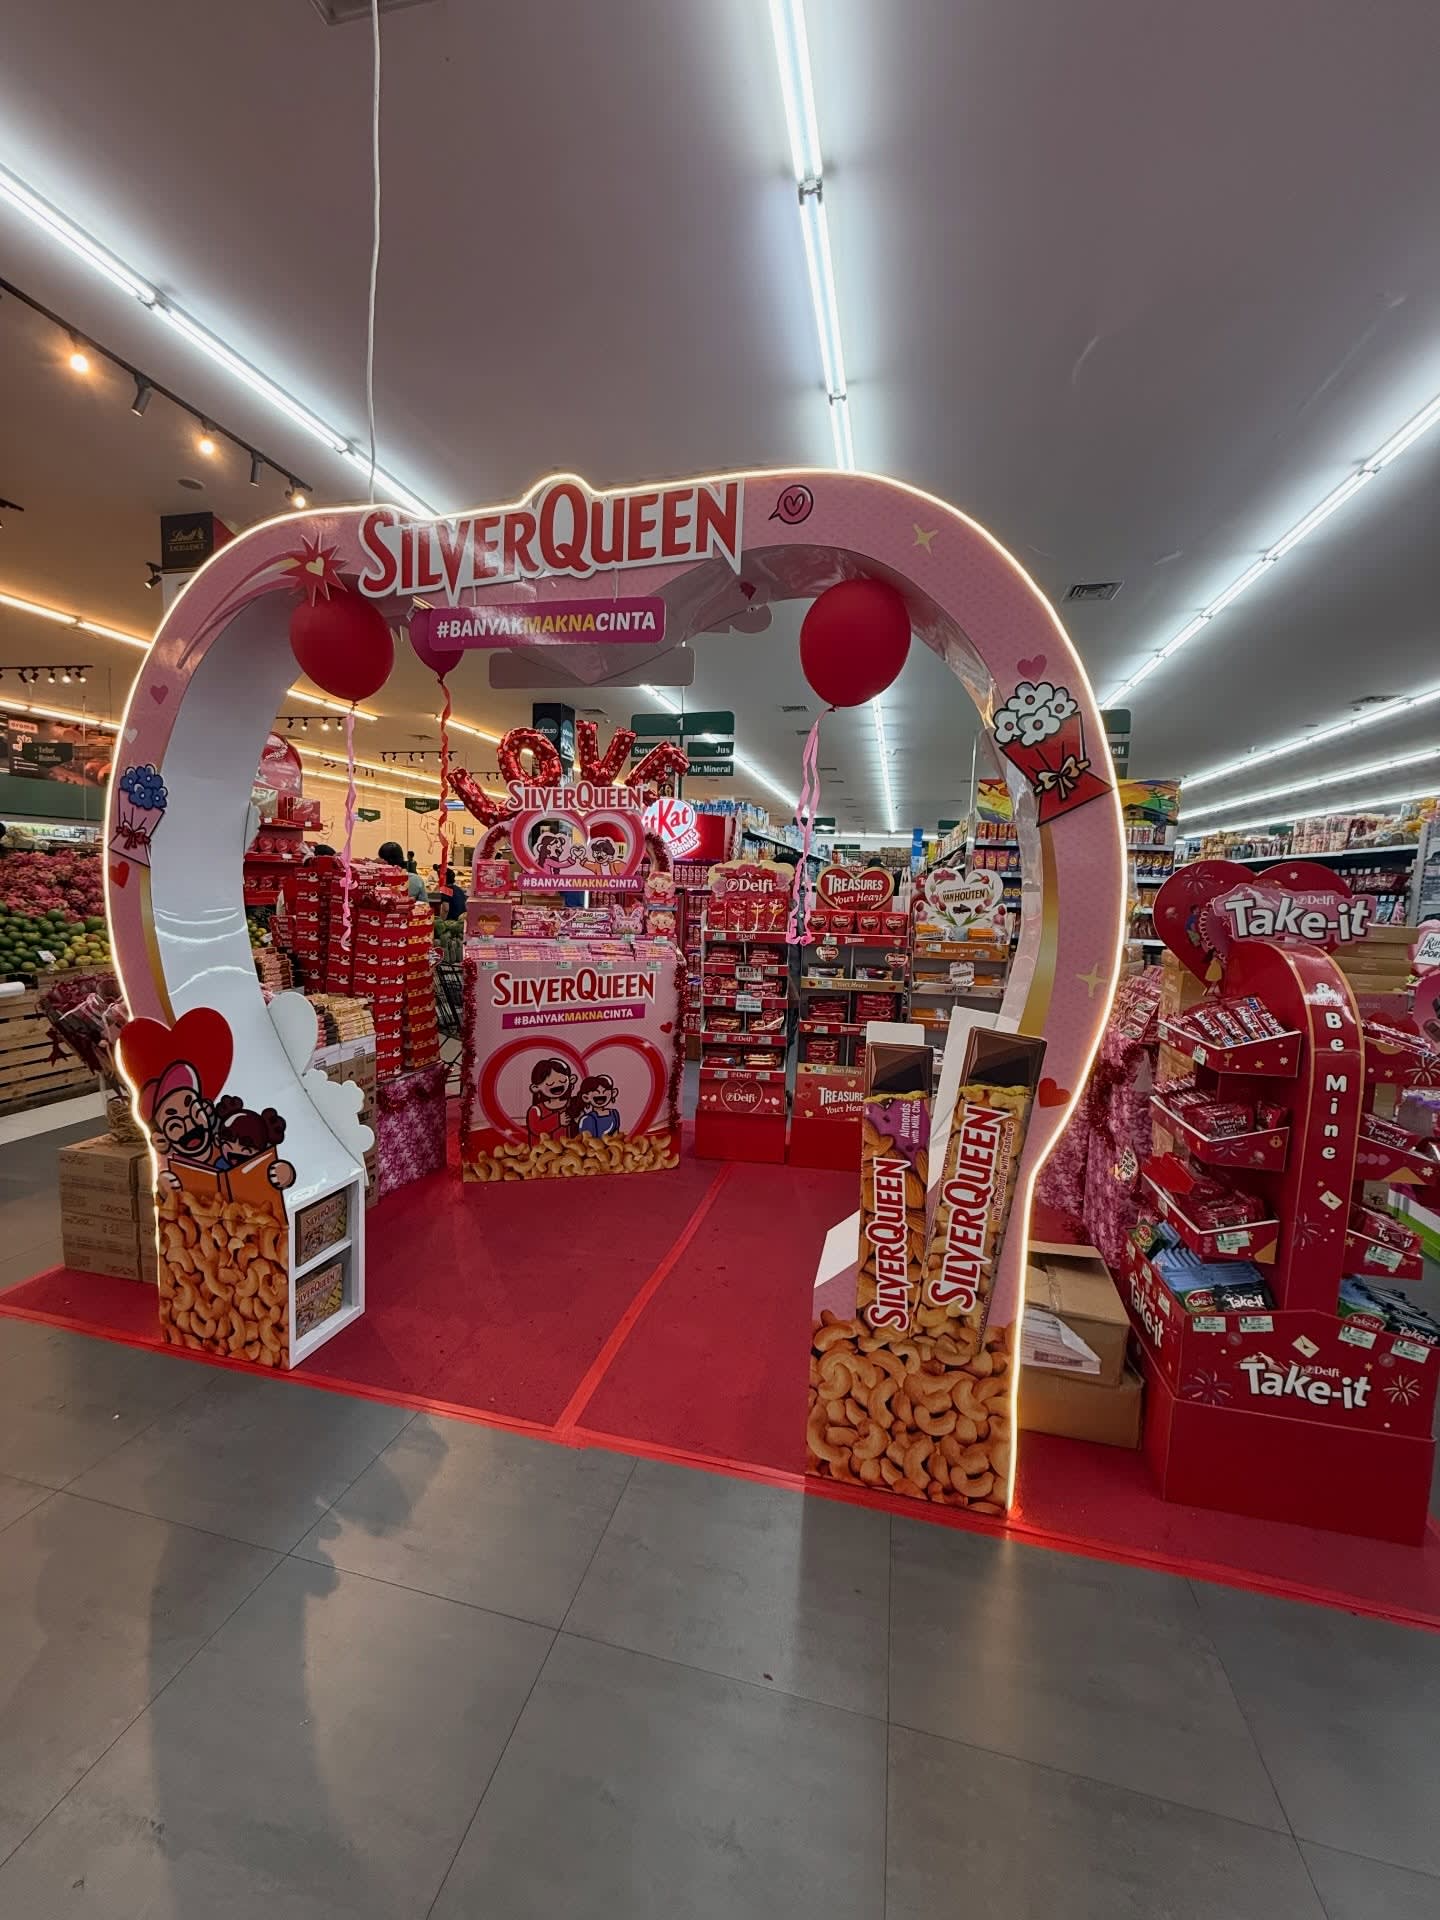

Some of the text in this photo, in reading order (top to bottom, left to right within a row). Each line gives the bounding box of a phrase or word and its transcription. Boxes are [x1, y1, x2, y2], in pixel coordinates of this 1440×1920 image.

[361, 482, 741, 602] SILVERQUEEN
[436, 610, 656, 639] #BANYAKMAKNACINTA
[716, 746, 730, 754] Jus
[691, 764, 731, 773] Air Mineral
[507, 782, 642, 812] SILVERQUEEN
[523, 878, 639, 890] #BANYAKMAKNACINTA
[739, 878, 774, 894] Delfi
[826, 874, 884, 896] TREASURES
[834, 891, 883, 905] Your Heart
[954, 889, 986, 902] HOUTEN
[1308, 895, 1335, 906] Delfi
[1225, 897, 1369, 941] Take-it
[493, 968, 655, 1010] SILVERQUEEN
[514, 1008, 633, 1026] #BANYAKMAKNACINTA
[733, 1093, 756, 1103] Delfi
[818, 1086, 865, 1106] TREASURE
[845, 1103, 865, 1113] Hear
[900, 1103, 911, 1138] Almonds
[930, 1105, 1012, 1311] SILVERQUEEN
[867, 1159, 911, 1330] SILVERQUEEN
[1227, 1294, 1266, 1309] Take-it
[1239, 1362, 1372, 1410] Take-it
